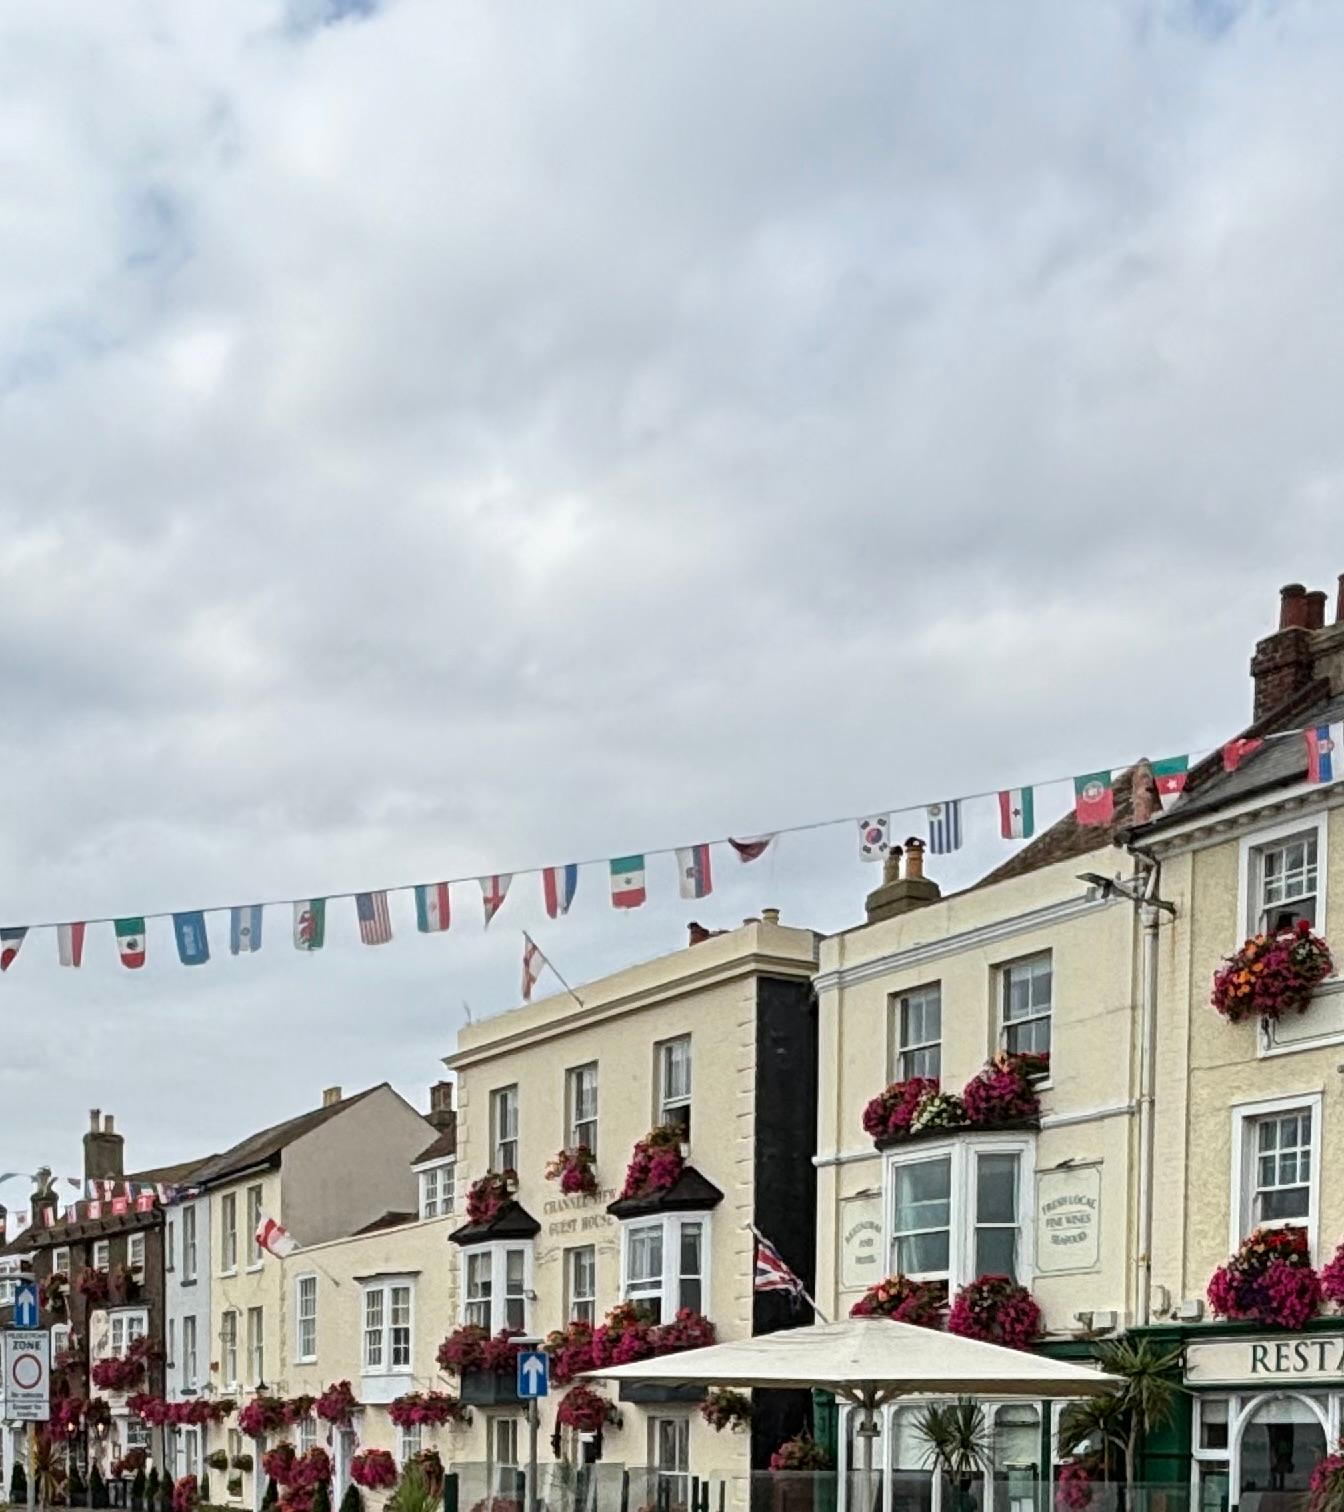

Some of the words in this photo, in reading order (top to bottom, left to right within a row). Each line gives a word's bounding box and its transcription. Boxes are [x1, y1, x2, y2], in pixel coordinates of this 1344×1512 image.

[549, 1219, 577, 1236] GUEST
[581, 1215, 614, 1231] HOUSE
[13, 1341, 41, 1350] ZONE
